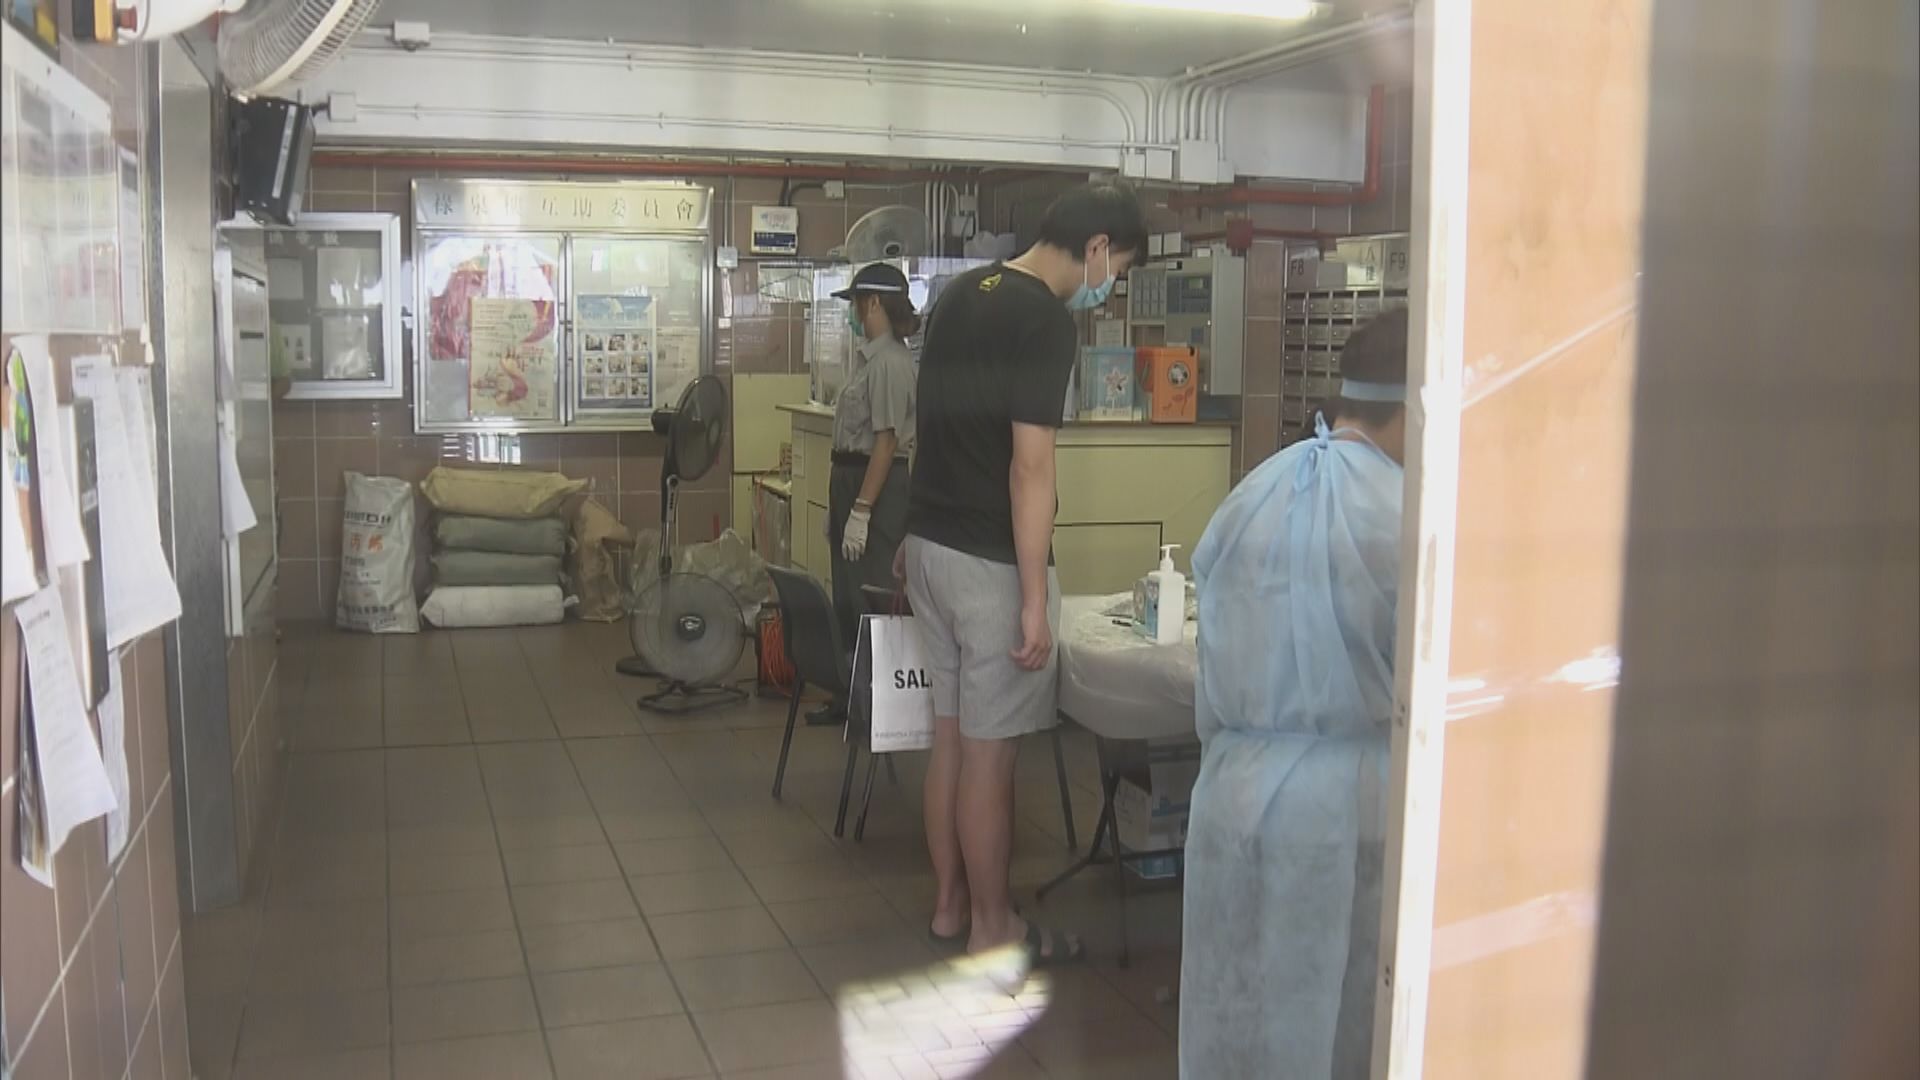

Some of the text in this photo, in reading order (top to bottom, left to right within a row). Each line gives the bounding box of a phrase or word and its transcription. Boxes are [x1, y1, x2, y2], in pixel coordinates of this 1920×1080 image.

[1289, 259, 1305, 276] F8
[1390, 252, 1406, 272] F9
[894, 668, 933, 689] SAL
